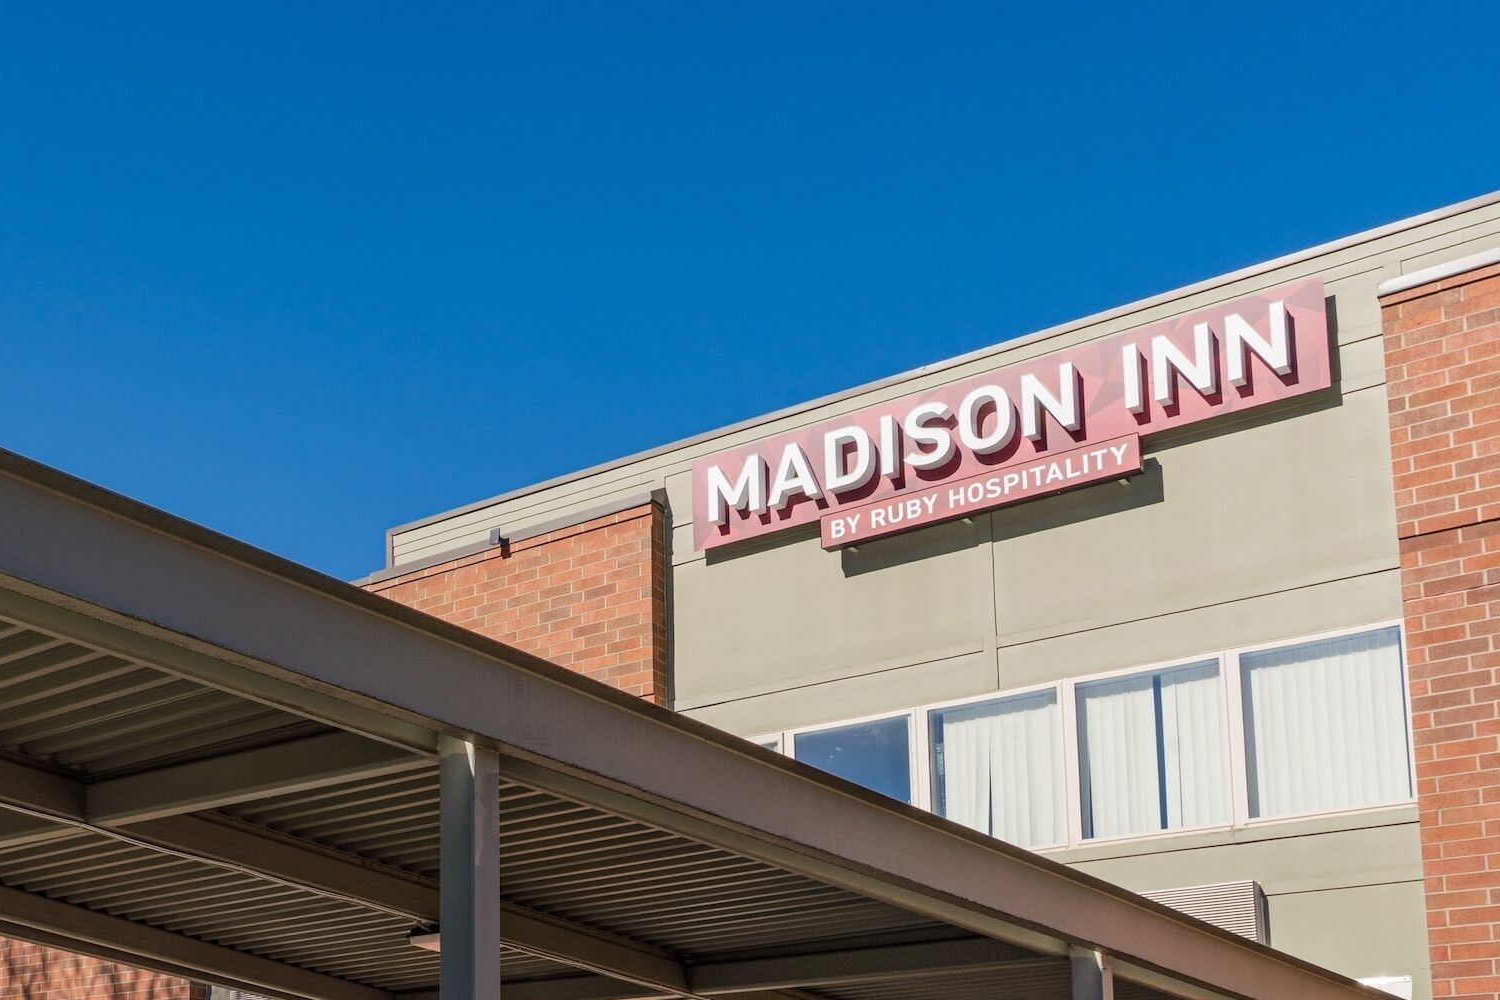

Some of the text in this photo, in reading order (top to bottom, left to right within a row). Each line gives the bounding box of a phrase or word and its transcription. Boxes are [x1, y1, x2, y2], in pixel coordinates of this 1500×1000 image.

[706, 300, 1291, 526] MADISON INN
[830, 443, 1128, 539] BY RUBY HOSPITALITY
